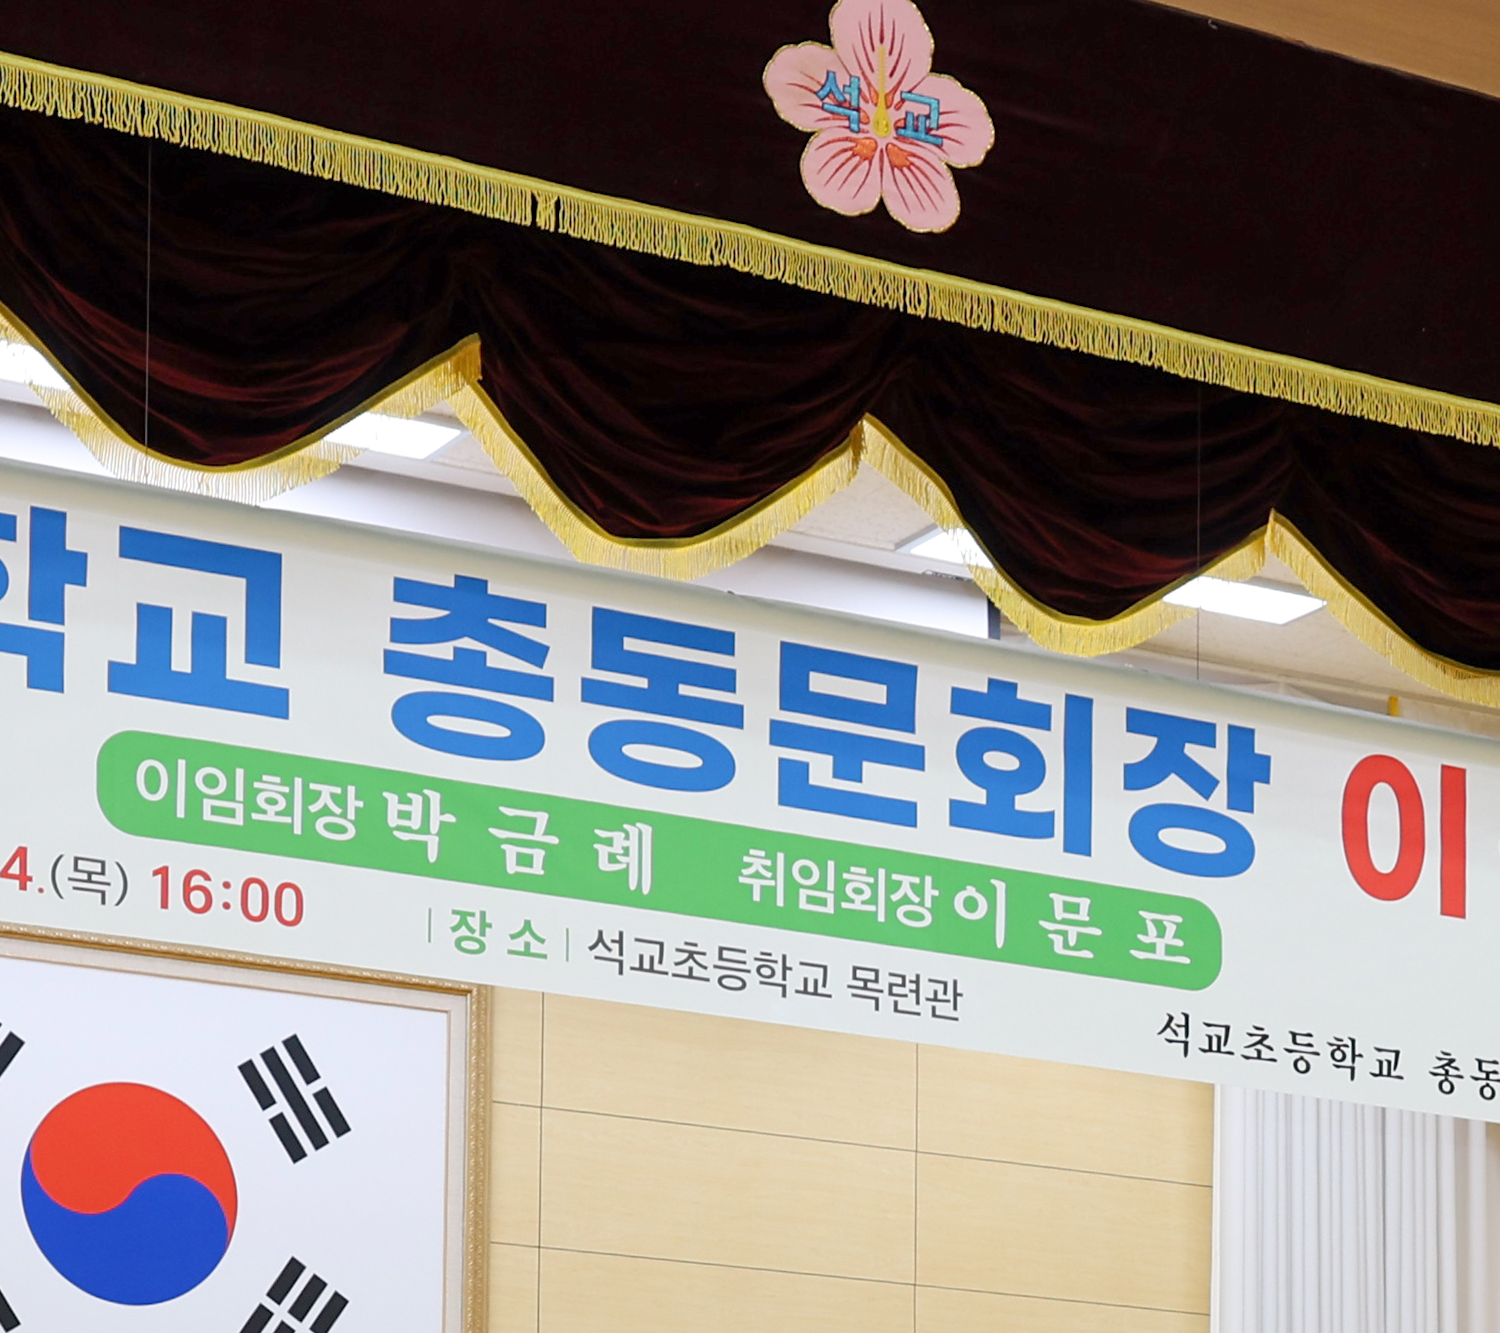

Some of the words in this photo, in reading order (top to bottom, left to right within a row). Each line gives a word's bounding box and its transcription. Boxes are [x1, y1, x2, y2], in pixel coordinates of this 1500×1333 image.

[383, 575, 1271, 878] 총동문회장
[134, 754, 364, 844] 이임회장
[737, 847, 940, 931] 취임회장
[152, 864, 305, 928] 16:00
[587, 929, 833, 999] 석교초등학교
[846, 963, 964, 1021] 목련관
[1157, 1012, 1405, 1082] 석교초등학교
